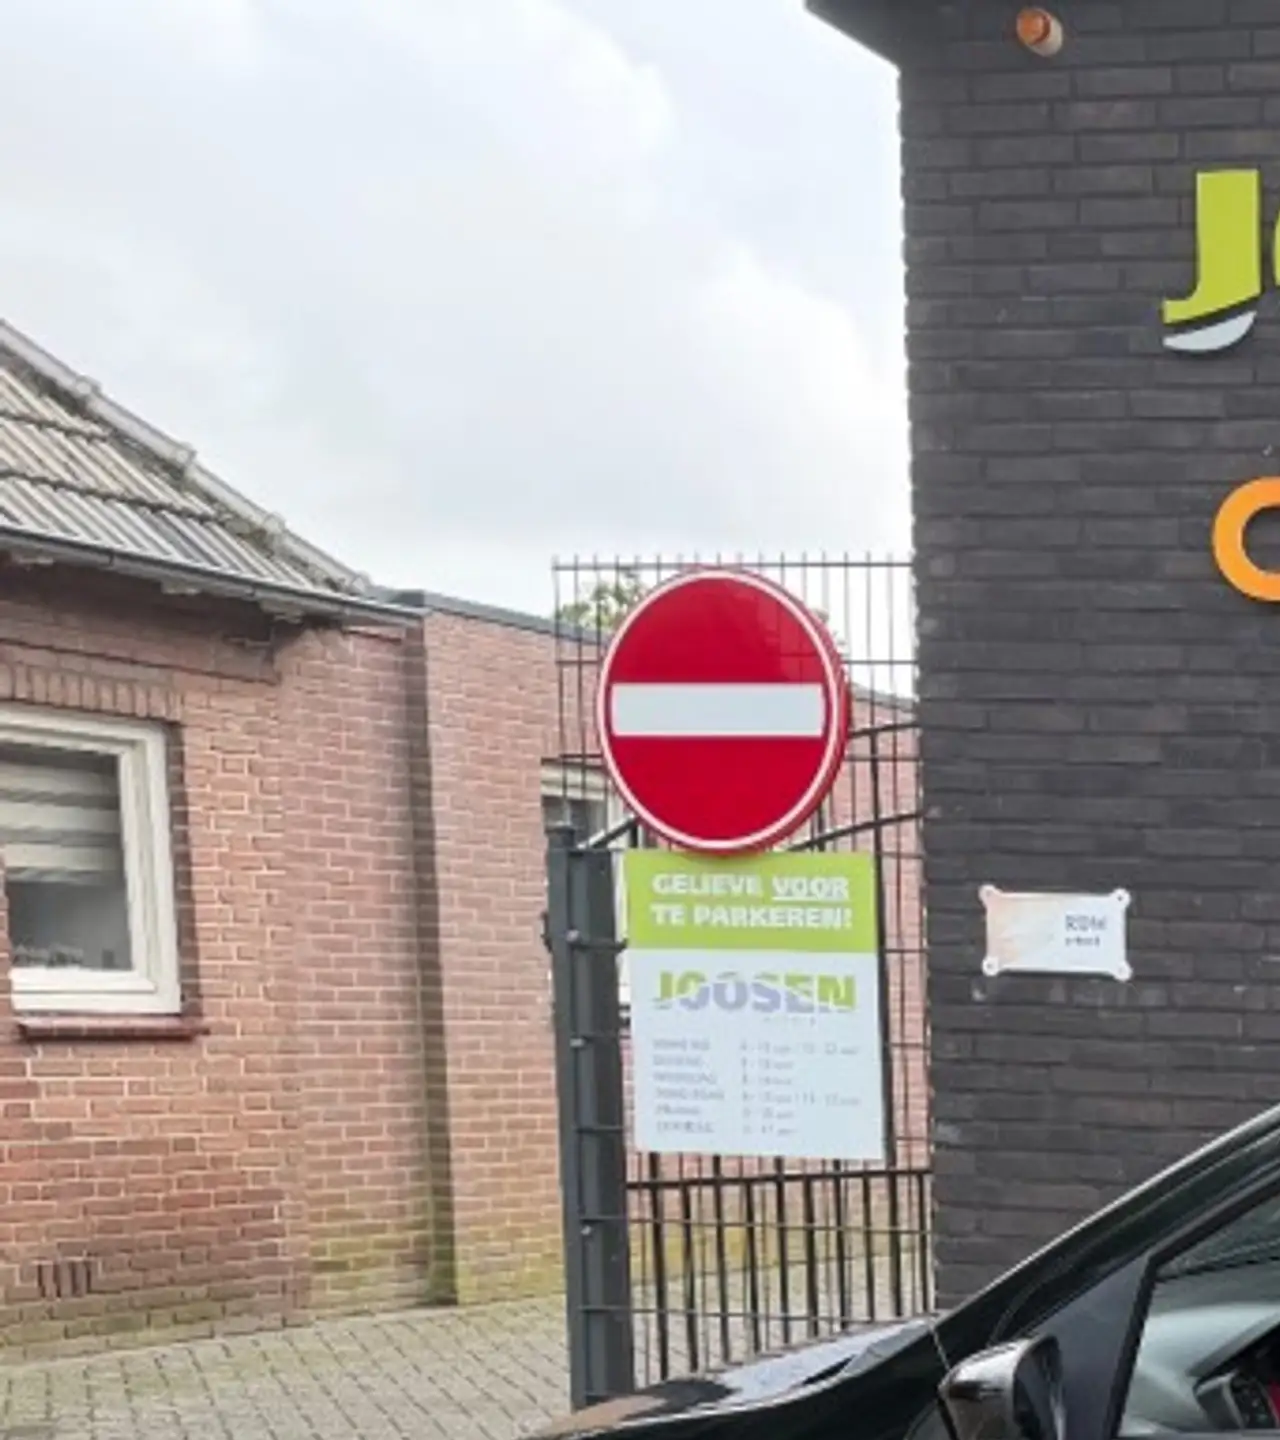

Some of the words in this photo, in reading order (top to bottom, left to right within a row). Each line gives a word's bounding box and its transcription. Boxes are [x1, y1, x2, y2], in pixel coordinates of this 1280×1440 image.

[651, 873, 764, 895] GELIEVE
[771, 876, 850, 900] VOOR
[651, 905, 686, 926] TE
[653, 969, 857, 1014] JOOSEN
